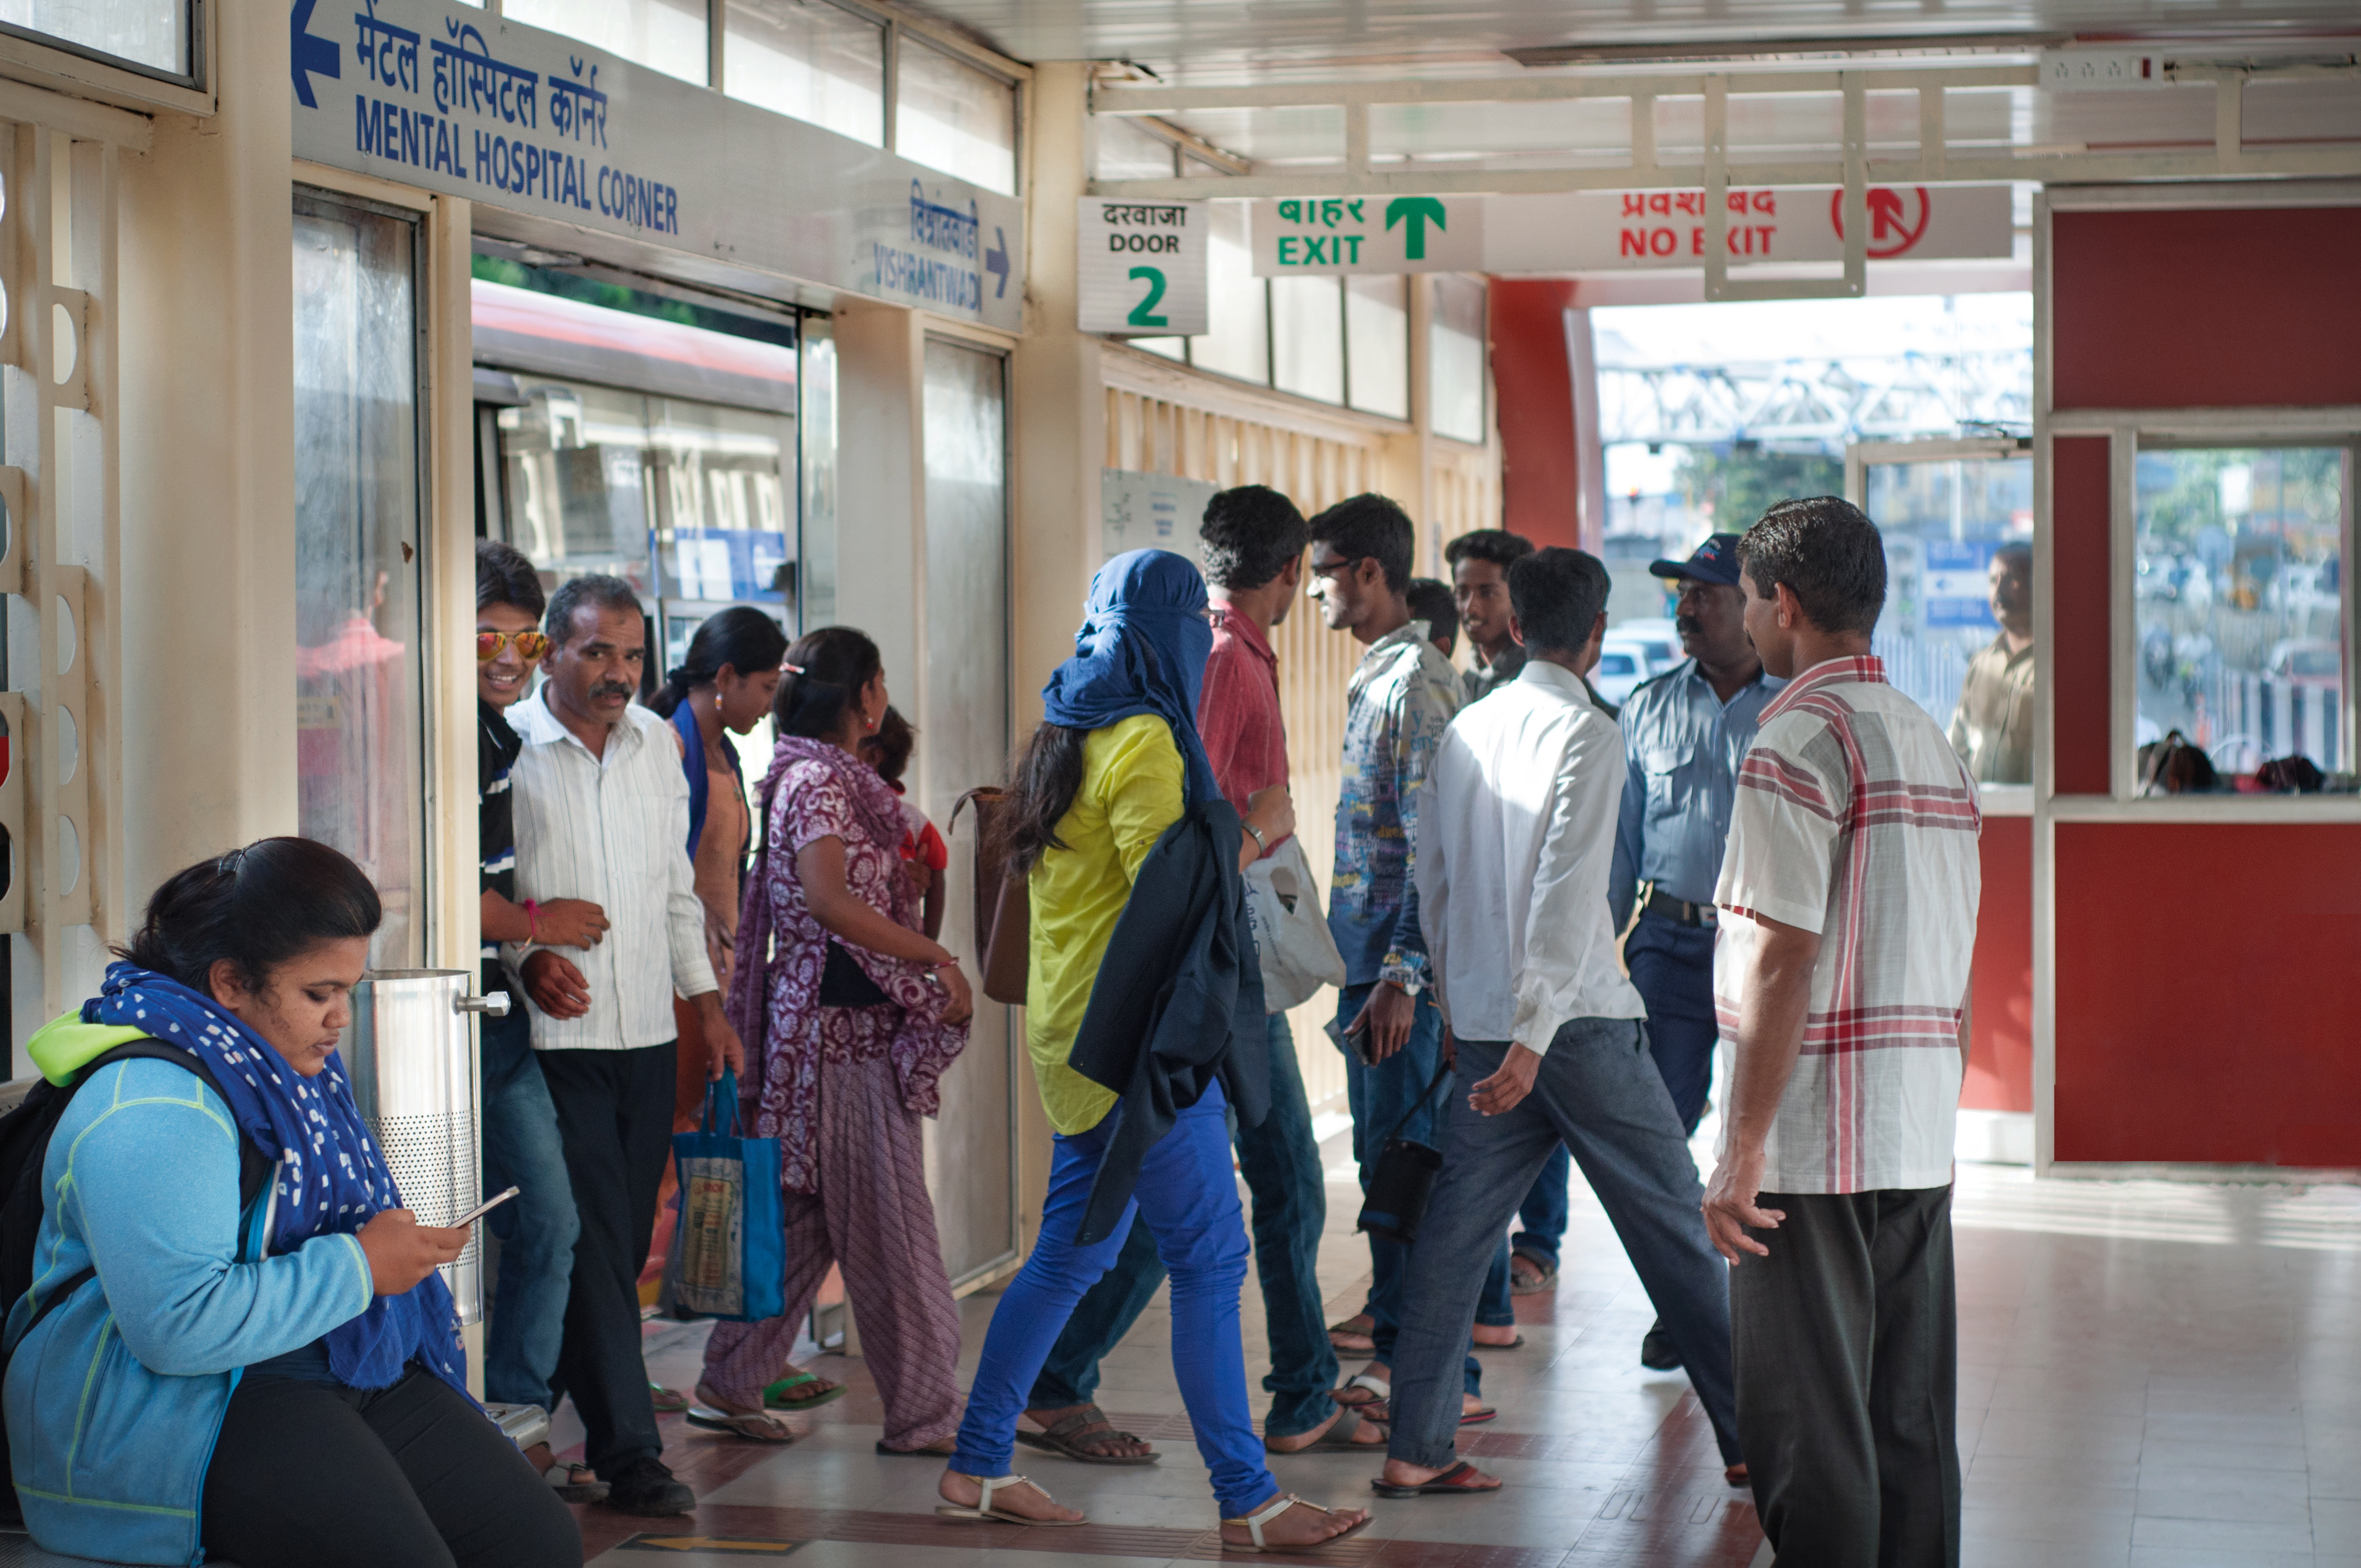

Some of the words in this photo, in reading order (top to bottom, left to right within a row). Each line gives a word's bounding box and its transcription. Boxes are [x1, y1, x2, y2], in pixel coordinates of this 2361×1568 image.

[430, 15, 538, 129] हॉस्पिटल
[548, 56, 608, 149] कॉर्नर
[356, 94, 466, 179] MENTAL
[475, 129, 591, 210] HOSPITAL
[597, 166, 678, 235] CORNER
[1102, 204, 1188, 227] दरवाजा
[1109, 233, 1179, 253] DOOR
[1279, 236, 1364, 265] EXIT
[1620, 227, 1677, 257] NO
[1128, 266, 1168, 327] 2
